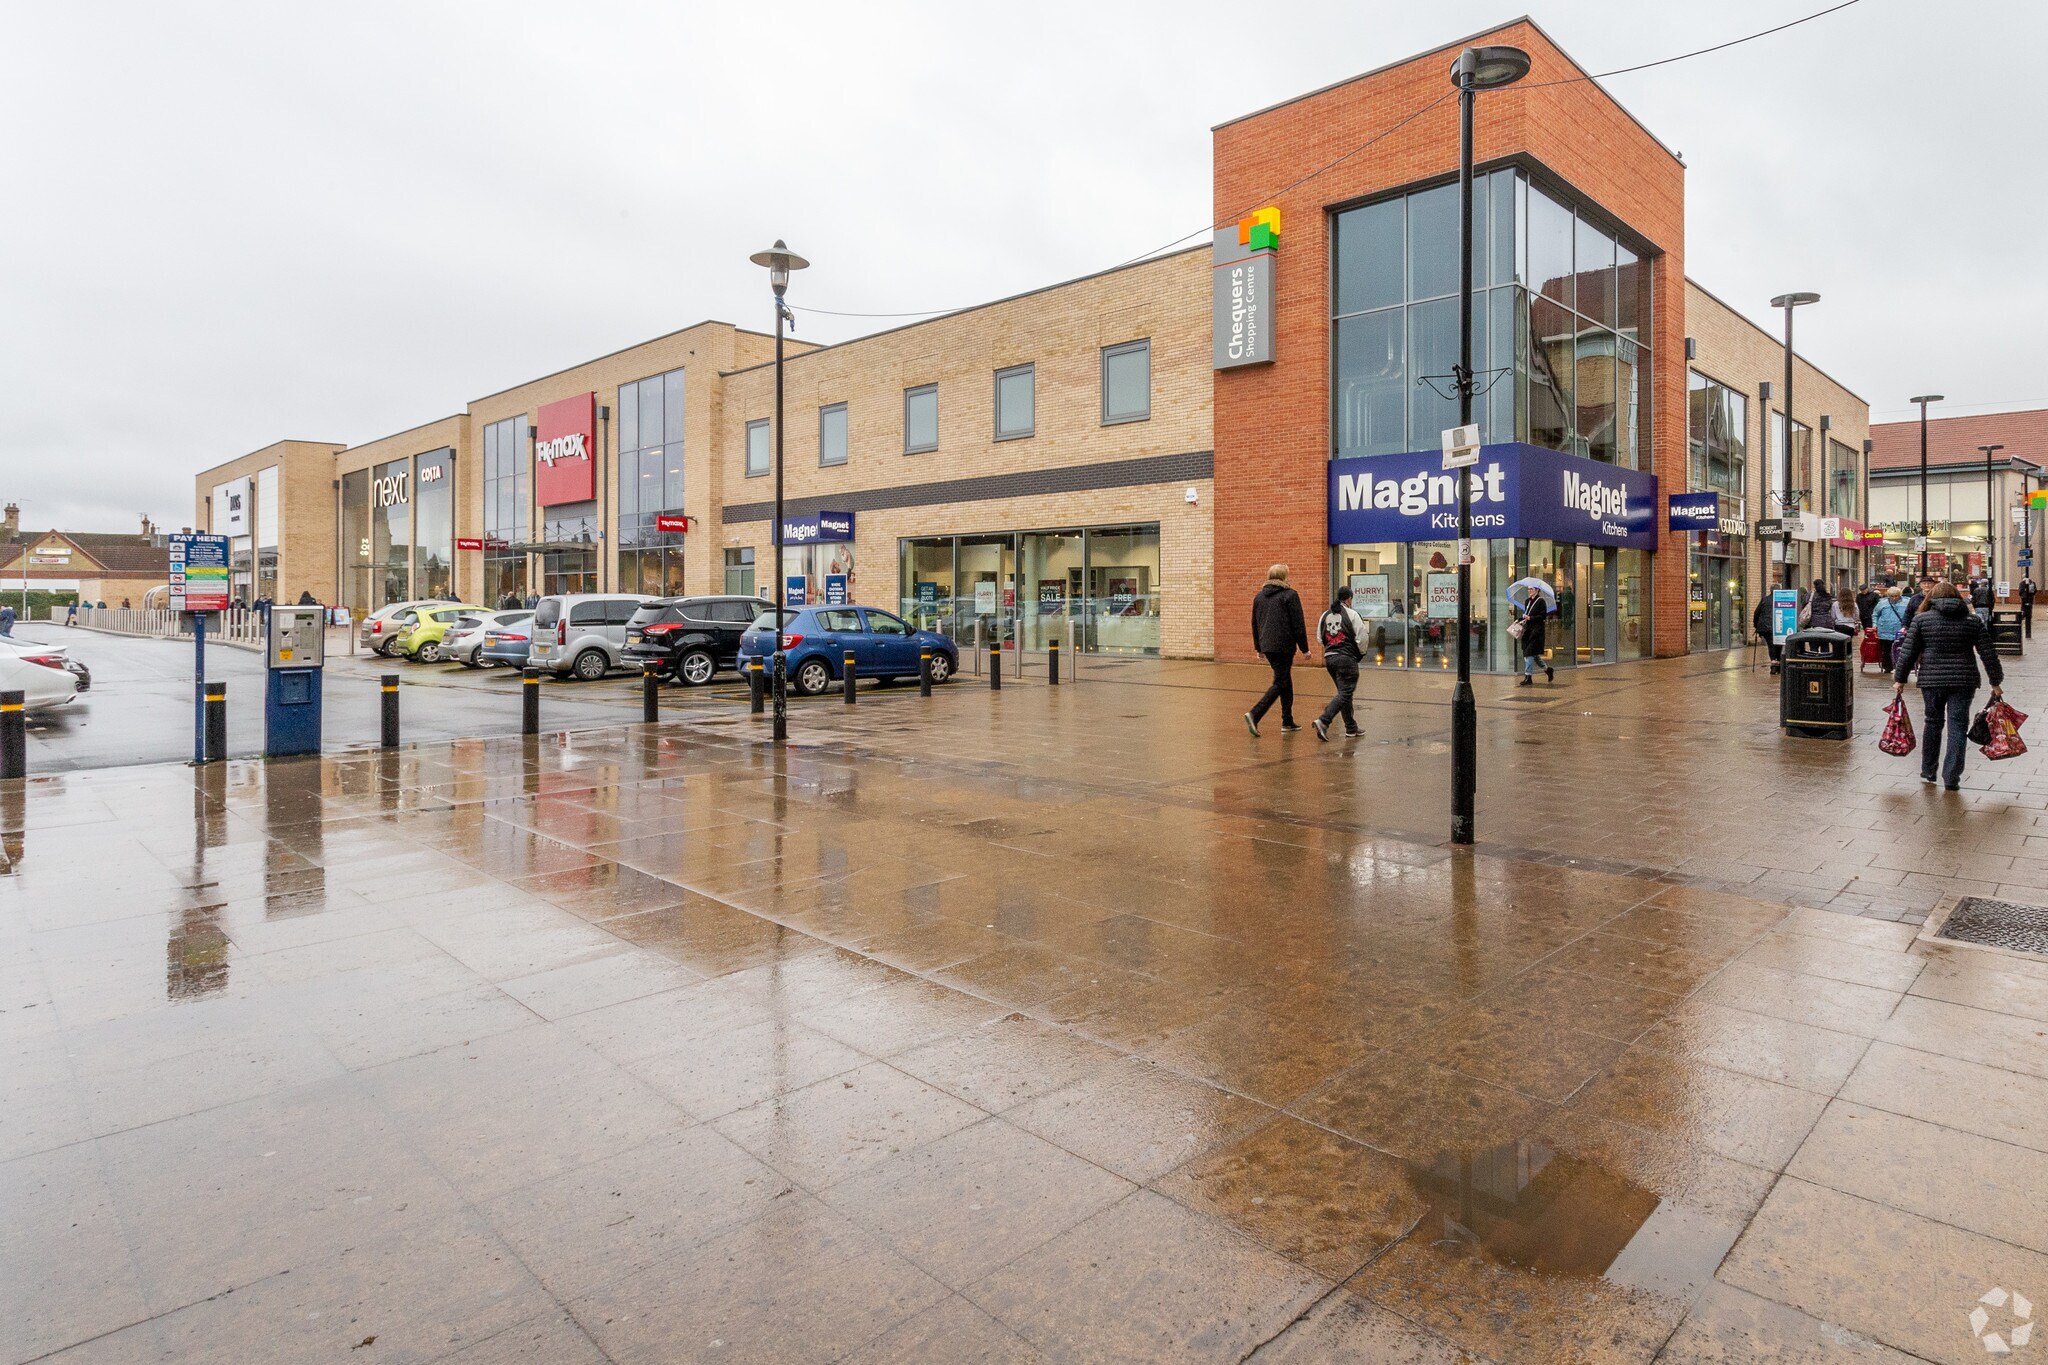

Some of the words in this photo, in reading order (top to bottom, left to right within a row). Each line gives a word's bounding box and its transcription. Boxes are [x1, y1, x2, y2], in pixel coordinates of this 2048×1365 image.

[1245, 265, 1255, 303] Centre
[1228, 267, 1247, 360] Chequers
[1245, 304, 1257, 358] Shopping
[421, 465, 442, 482] COSTA
[373, 471, 408, 508] next
[1563, 469, 1627, 520] Magnet
[1670, 504, 1716, 517] Magnet
[783, 523, 818, 541] Magne
[821, 520, 849, 530] Magnet
[1602, 520, 1628, 538] Kitchens
[1879, 520, 1950, 533] BARRTT
[196, 535, 225, 543] HERE
[1040, 593, 1061, 602] SALE
[1113, 593, 1132, 602] FREE
[1354, 587, 1384, 595] HURRY!
